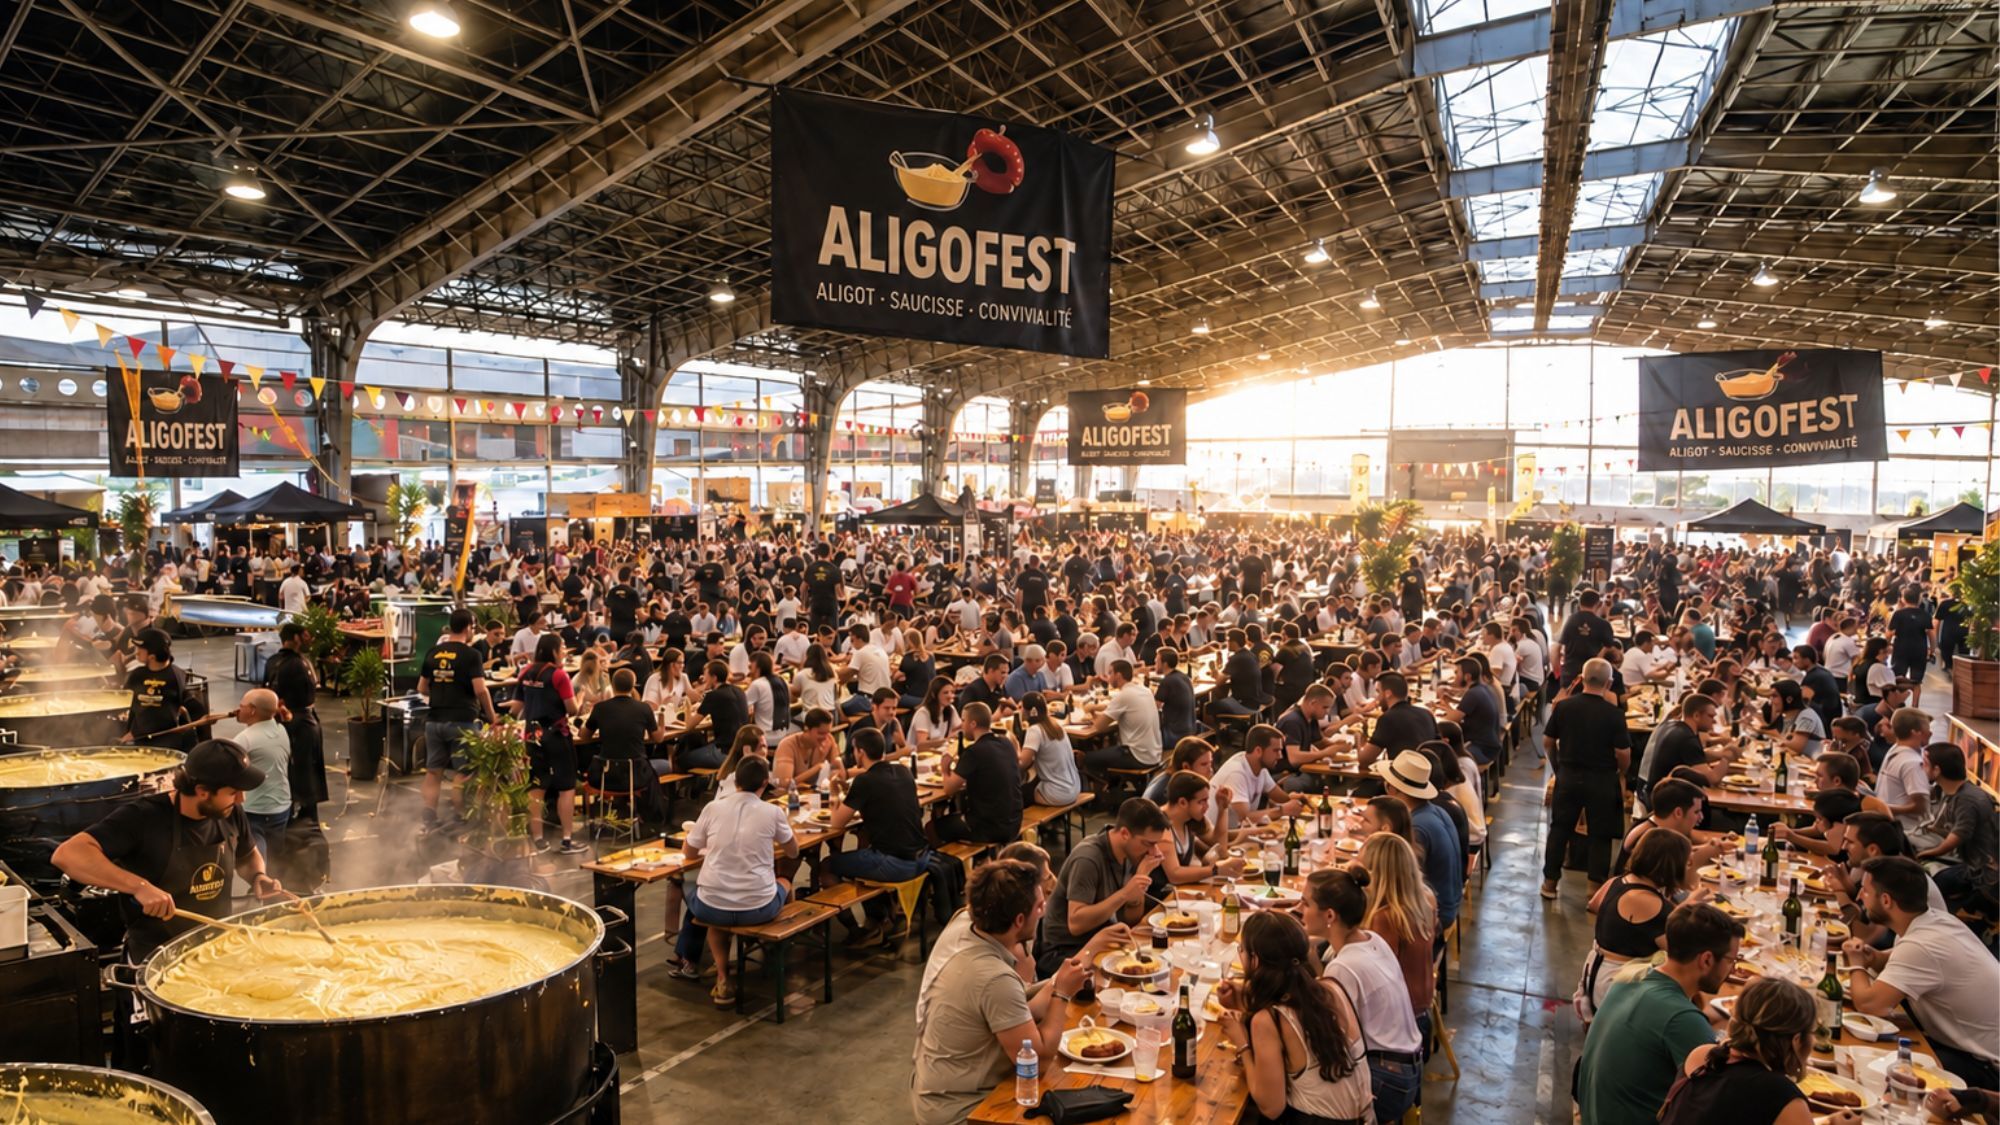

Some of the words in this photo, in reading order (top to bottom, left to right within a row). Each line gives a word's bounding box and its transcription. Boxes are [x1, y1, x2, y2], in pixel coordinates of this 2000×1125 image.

[818, 205, 1076, 294] ALIGOFEST
[816, 281, 876, 306] ALIGOT
[890, 291, 964, 317] SAUCISSE
[978, 302, 1072, 328] CONVIVIALITÉ
[125, 419, 226, 449] ALIGOFEST
[1081, 424, 1172, 447] ALIGOFEST
[1669, 394, 1858, 440] ALIGOFEST
[1669, 446, 1709, 458] ALIGOT
[1719, 445, 1773, 457] SAUCISSE
